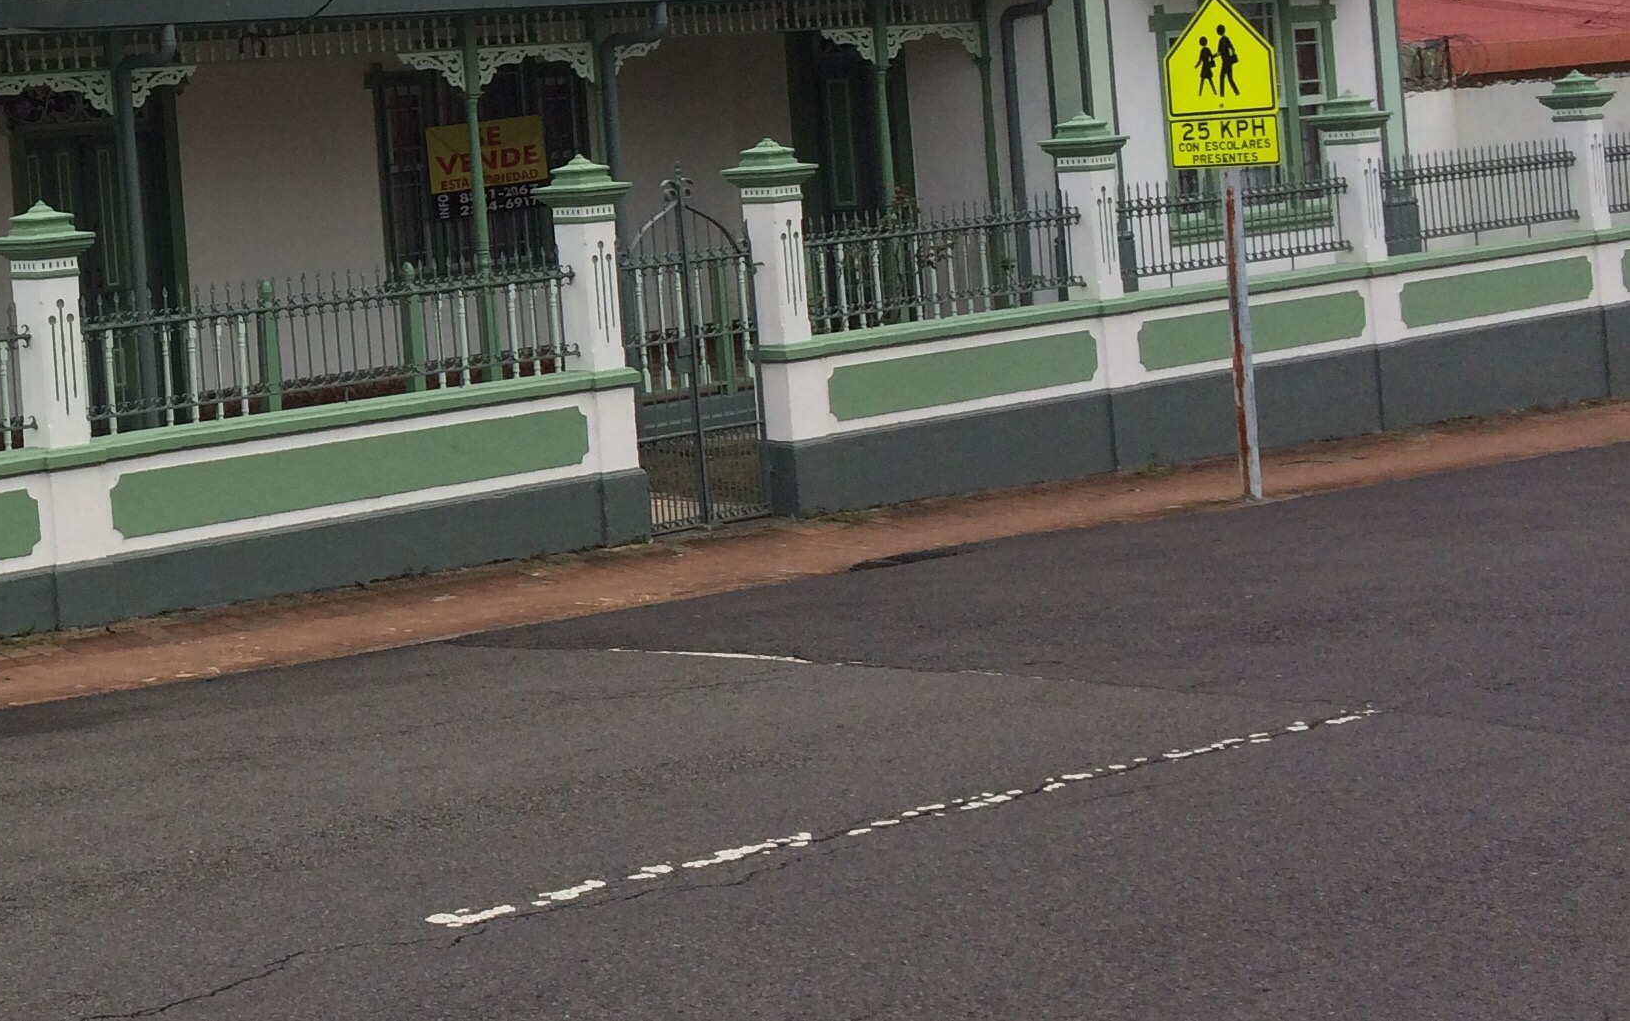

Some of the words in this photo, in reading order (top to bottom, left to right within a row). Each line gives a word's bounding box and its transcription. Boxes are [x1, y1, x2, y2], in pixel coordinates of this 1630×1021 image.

[1182, 122, 1210, 141] 25
[1220, 118, 1266, 139] KPH
[1178, 142, 1200, 152] CON
[1205, 138, 1271, 152] ESCOLARES
[1192, 152, 1259, 164] PRESENTES
[441, 177, 470, 191] ESTA
[482, 169, 539, 184] OPIEDAD
[437, 194, 450, 219] INFO
[459, 196, 538, 217] 24-6917
